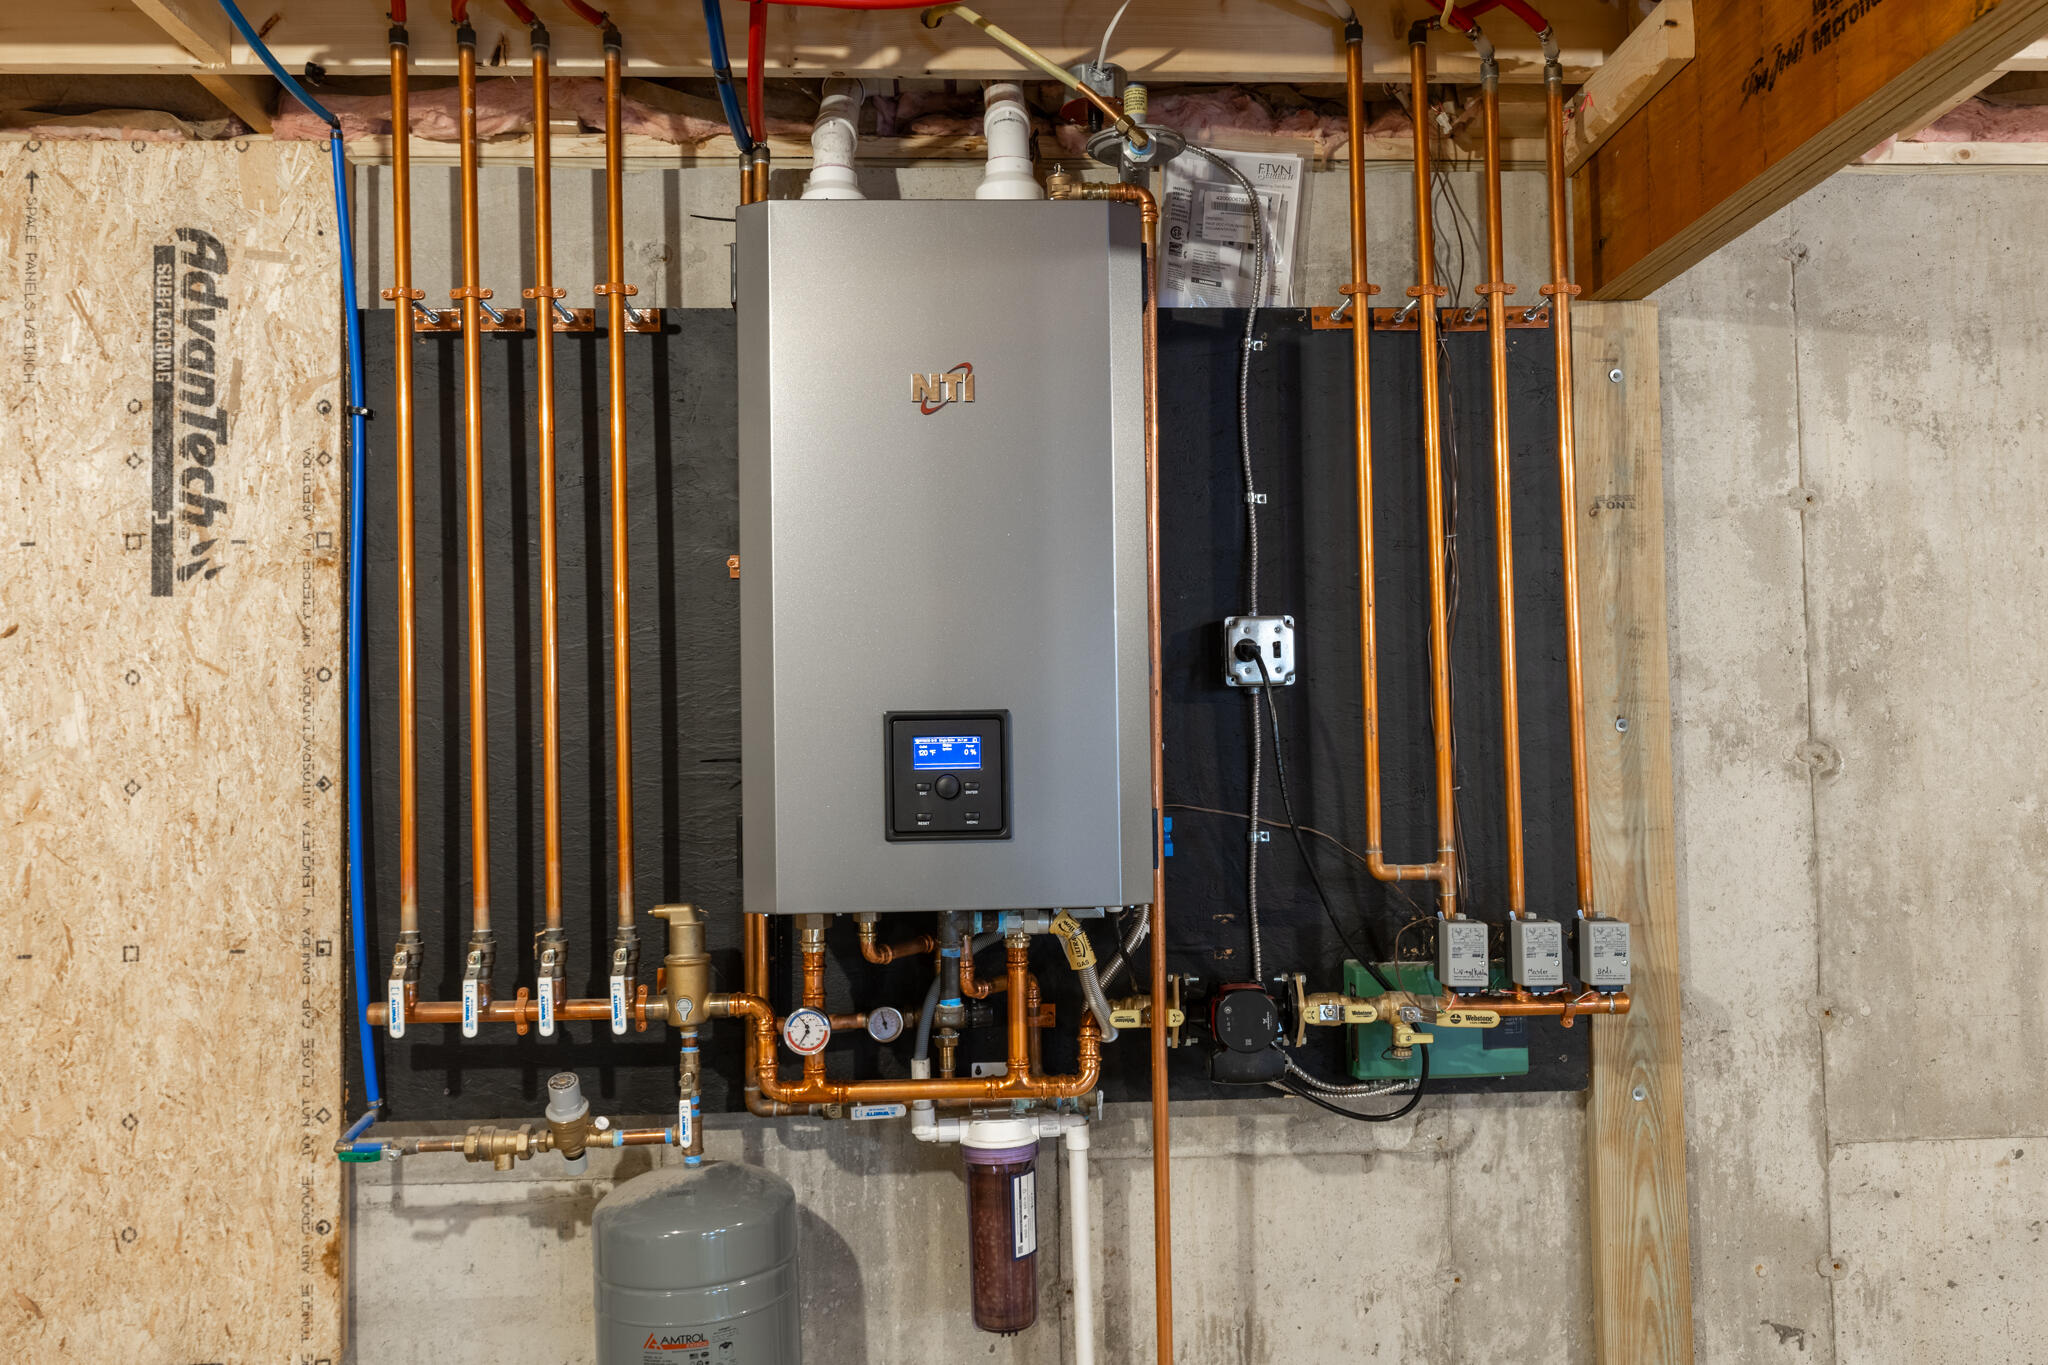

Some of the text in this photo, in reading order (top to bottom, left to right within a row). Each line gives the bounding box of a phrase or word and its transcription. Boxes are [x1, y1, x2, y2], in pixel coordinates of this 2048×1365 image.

[1258, 163, 1292, 175] FTVN
[23, 197, 37, 384] SPACE PANELS 1/8 INCH
[154, 262, 173, 383] SUBFLOORING
[176, 227, 229, 529] AdvanTech
[911, 373, 975, 403] NTI
[1076, 960, 1090, 968] GAS
[1465, 1014, 1493, 1022] Webstone
[660, 1333, 706, 1345] AMTROL
